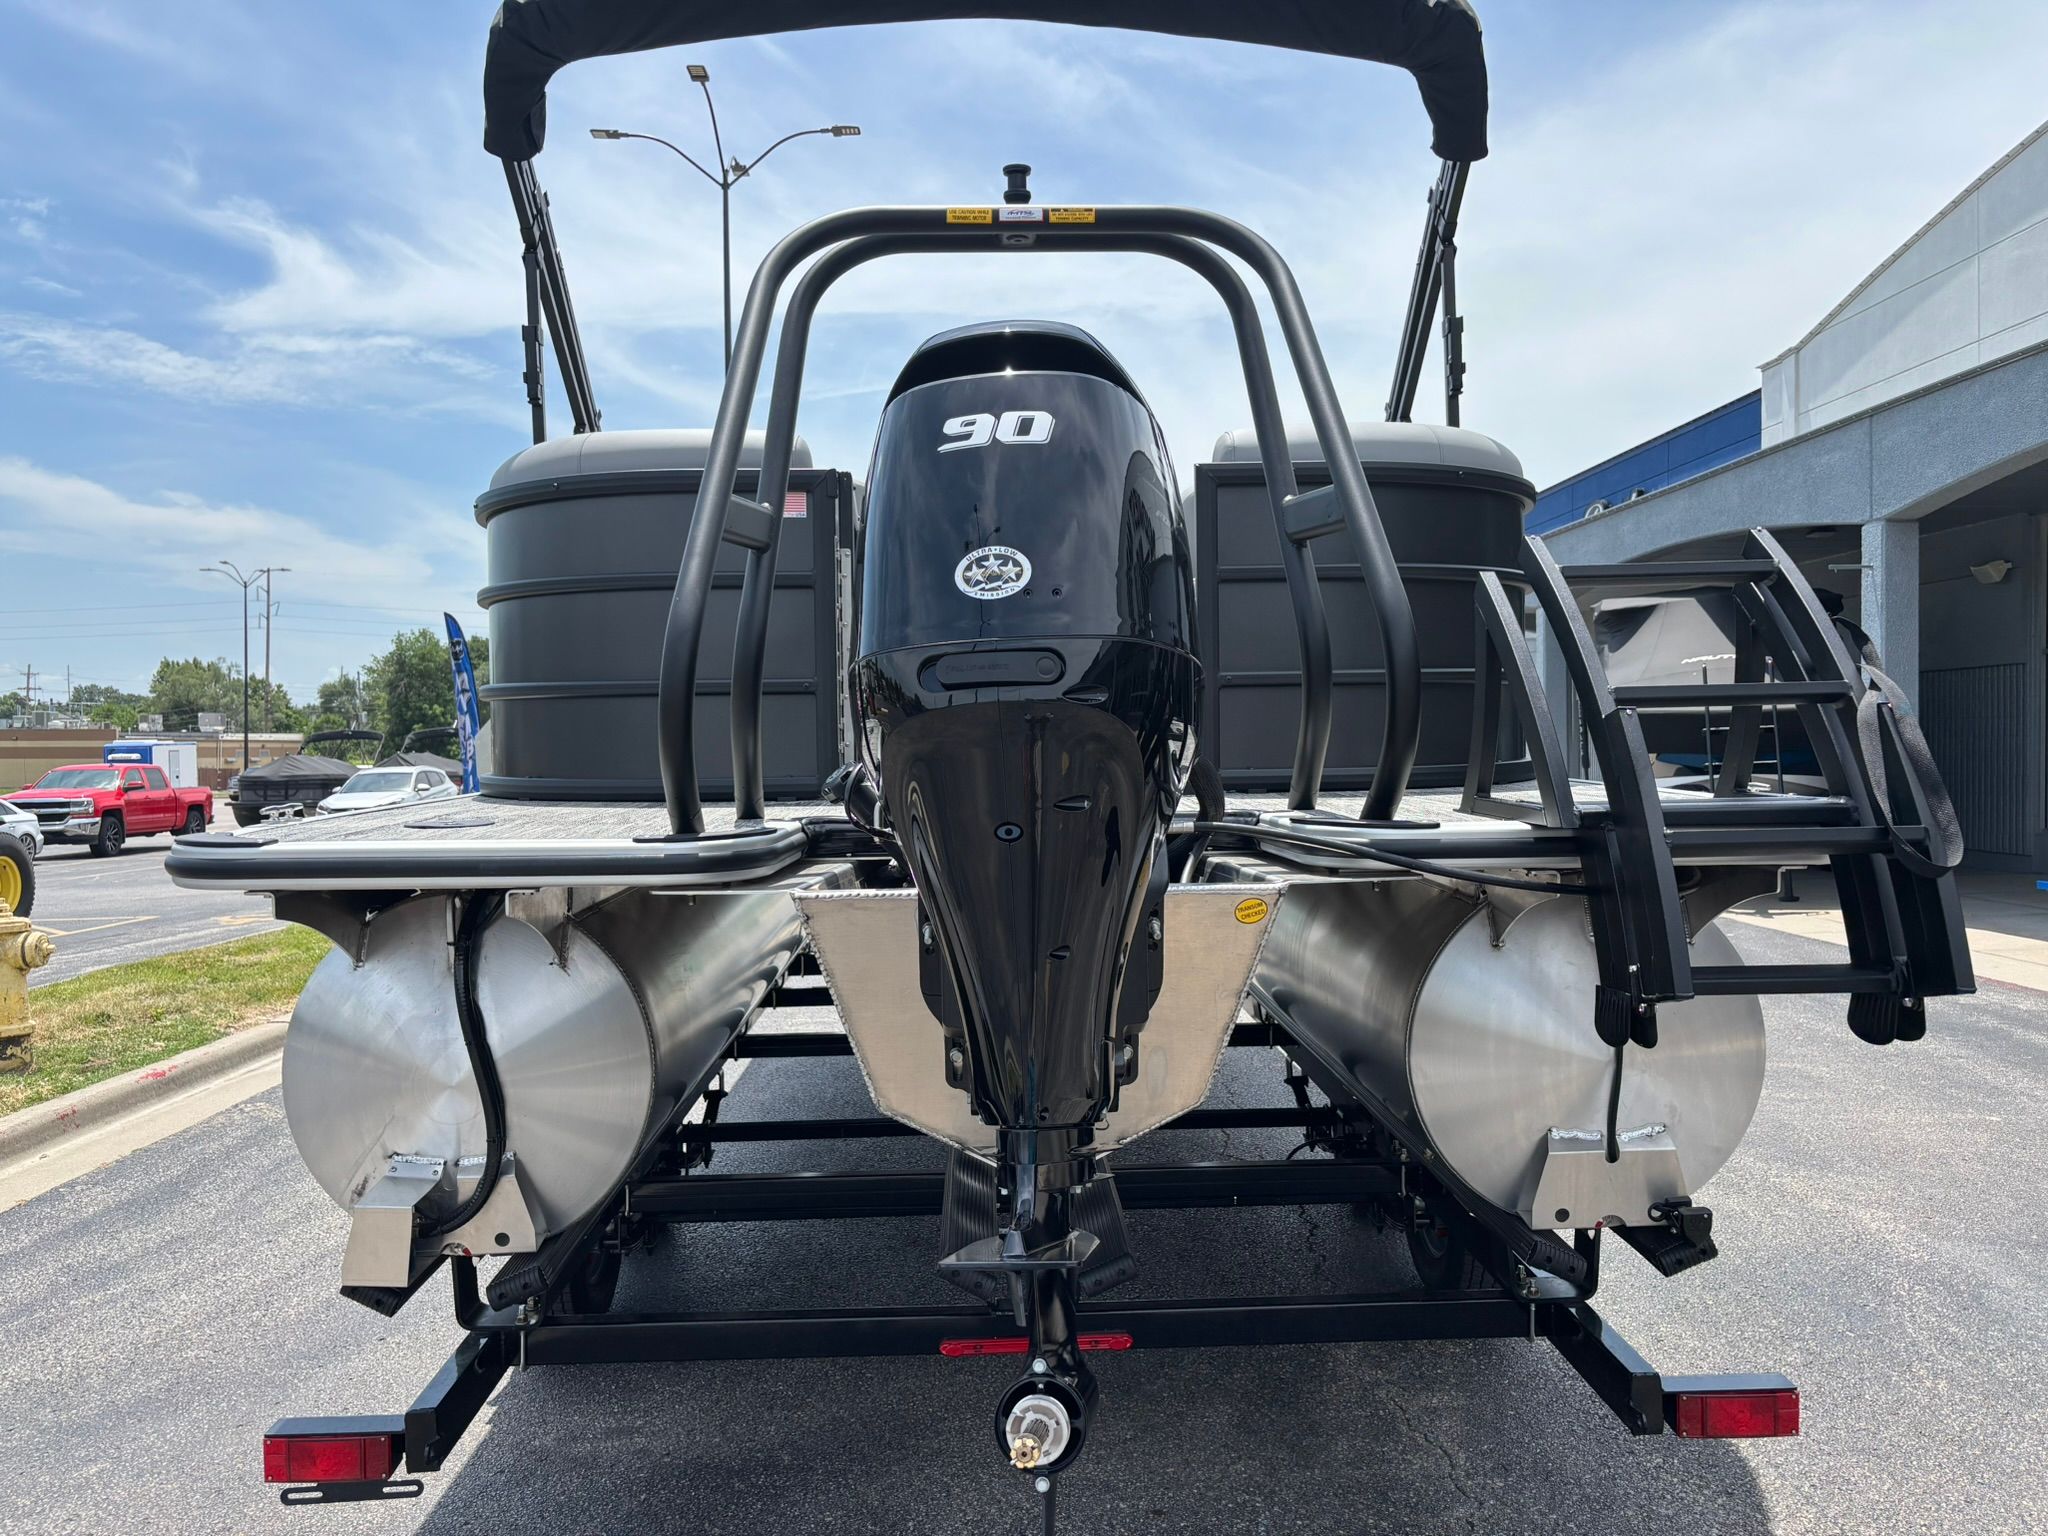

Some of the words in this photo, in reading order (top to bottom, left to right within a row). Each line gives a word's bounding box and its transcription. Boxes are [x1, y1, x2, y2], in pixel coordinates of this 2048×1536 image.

[937, 410, 1055, 453] 90
[966, 547, 993, 562] ULTRA
[998, 547, 1018, 557] LOW
[974, 588, 1015, 598] EMISSION
